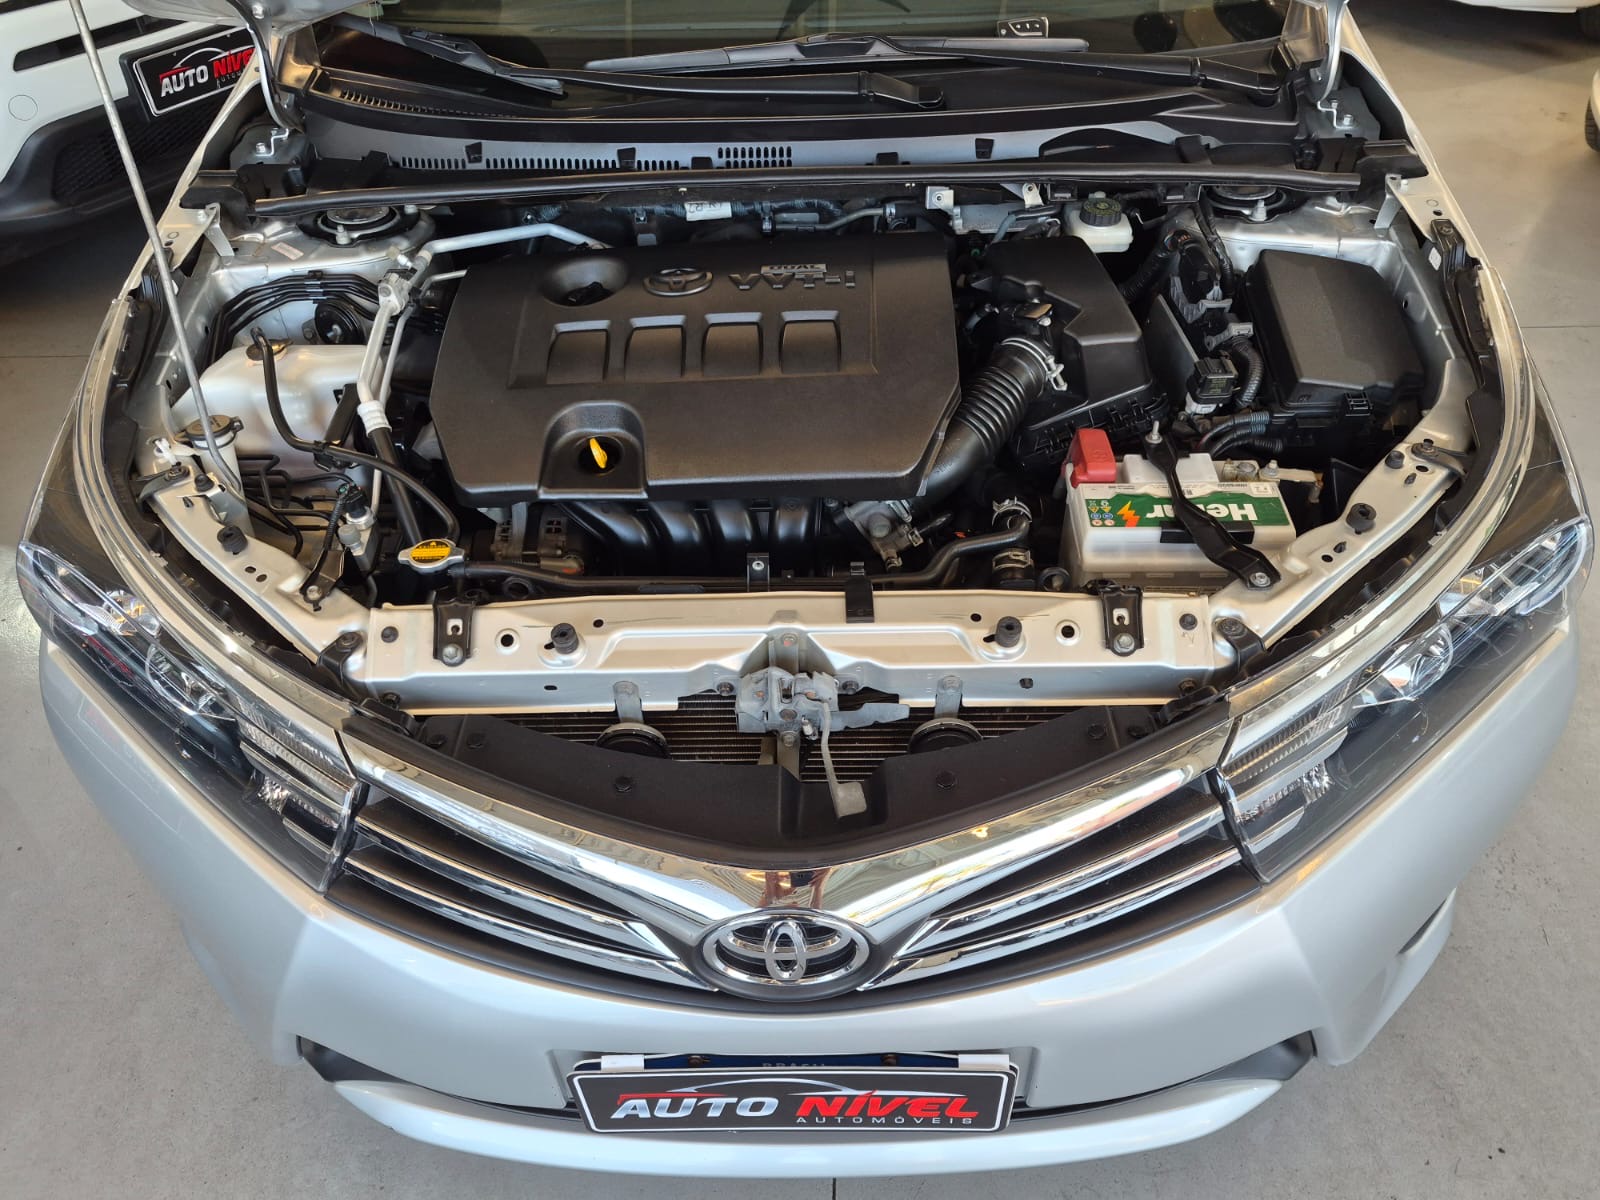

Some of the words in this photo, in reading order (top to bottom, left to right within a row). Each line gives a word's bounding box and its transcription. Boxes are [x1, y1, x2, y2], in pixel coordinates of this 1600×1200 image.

[160, 65, 209, 97] AUTO
[610, 1095, 779, 1120] AUTO
[796, 1089, 979, 1118] NÍVEL
[796, 1115, 973, 1125] AUTOMÓVEIS
